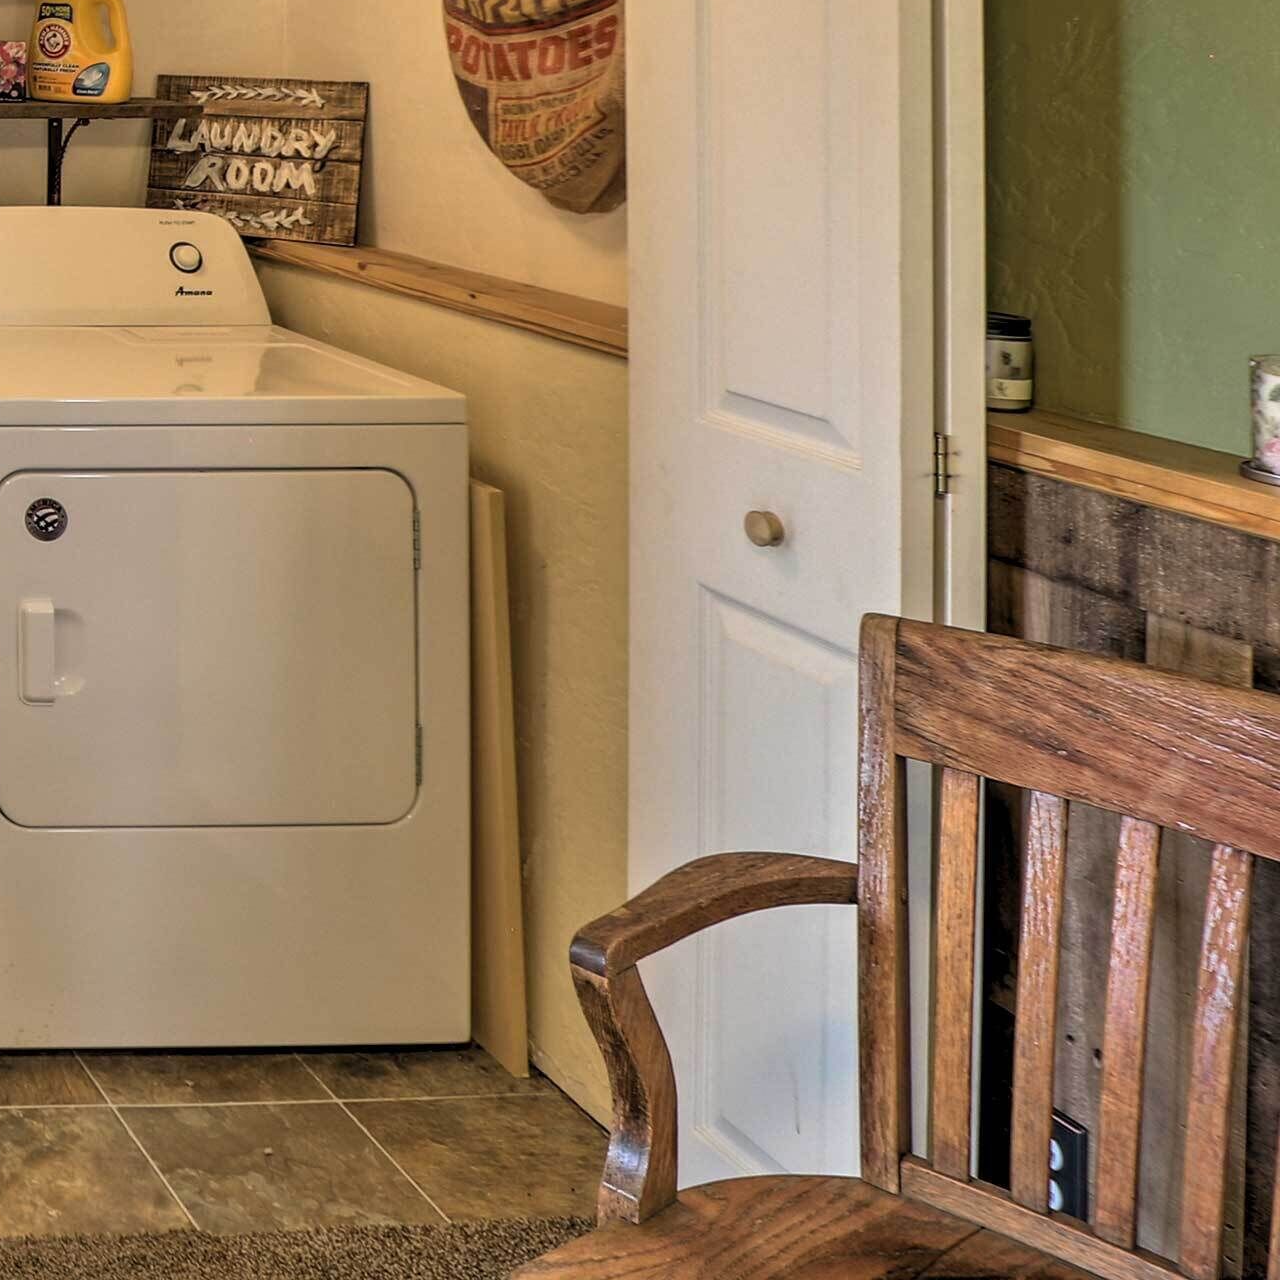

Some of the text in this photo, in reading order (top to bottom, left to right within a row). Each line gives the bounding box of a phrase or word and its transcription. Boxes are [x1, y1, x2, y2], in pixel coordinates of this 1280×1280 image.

[447, 15, 618, 82] POTATOES
[167, 117, 337, 161] LAUNDRY
[181, 154, 316, 196] ROOM
[175, 285, 214, 297] Amana
